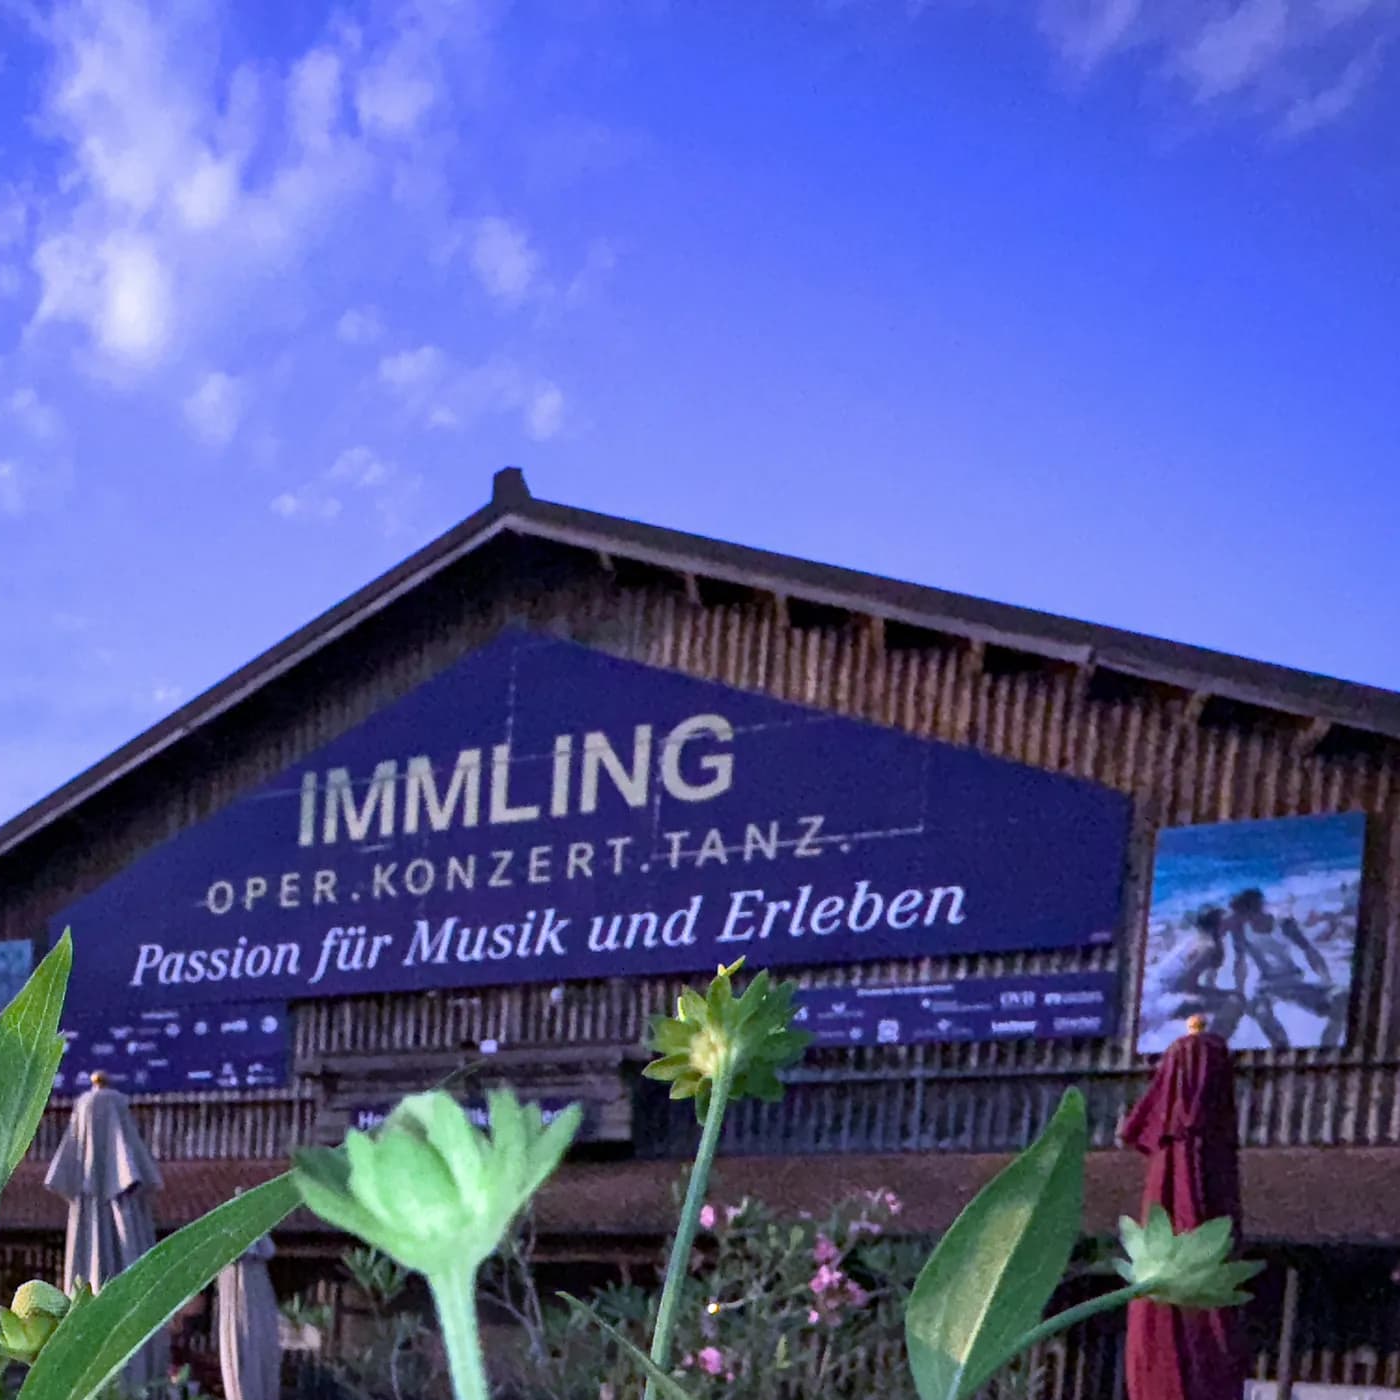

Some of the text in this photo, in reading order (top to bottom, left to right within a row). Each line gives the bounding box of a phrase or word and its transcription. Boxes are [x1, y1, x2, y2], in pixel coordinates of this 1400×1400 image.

[298, 713, 735, 847] IMMLING
[131, 880, 967, 986] Passion für Musik und Erleben
